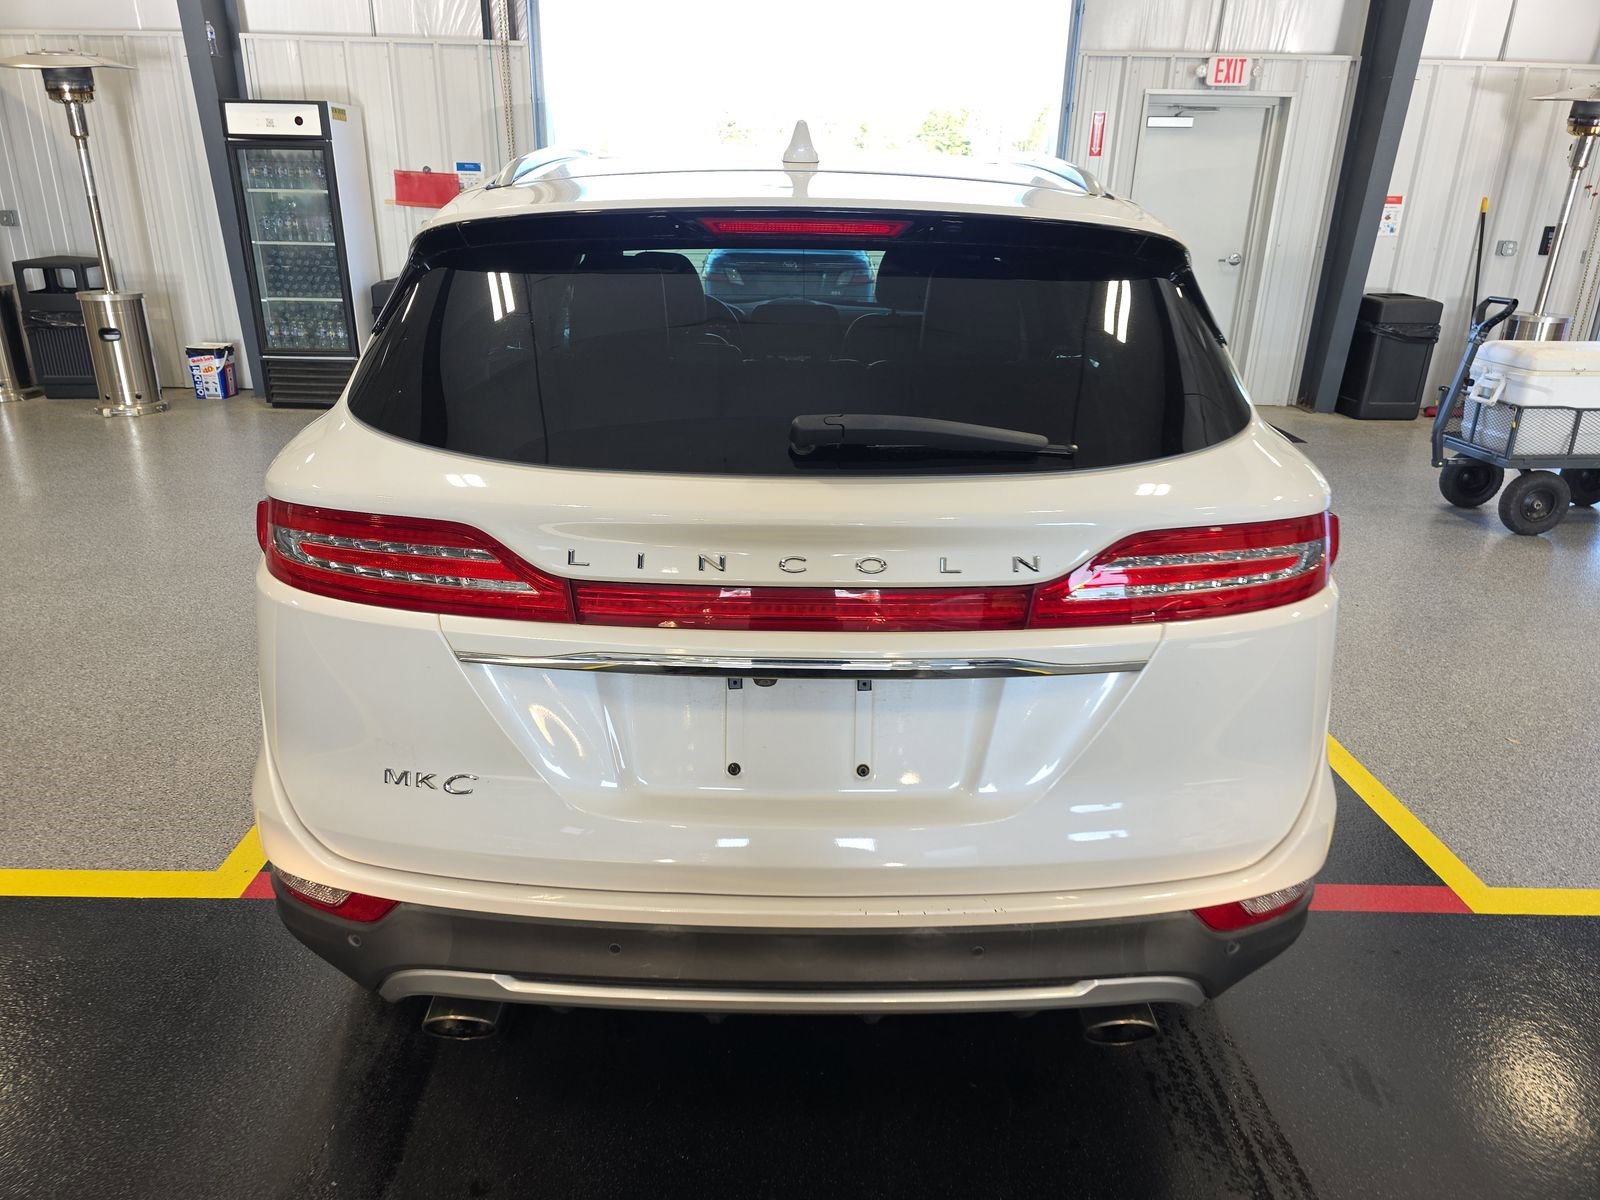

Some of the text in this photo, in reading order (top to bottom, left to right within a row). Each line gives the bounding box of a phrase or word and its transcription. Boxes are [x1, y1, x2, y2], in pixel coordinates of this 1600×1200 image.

[1214, 58, 1247, 83] EXIT
[568, 549, 1041, 574] LINCOLN
[384, 768, 479, 795] MKC
